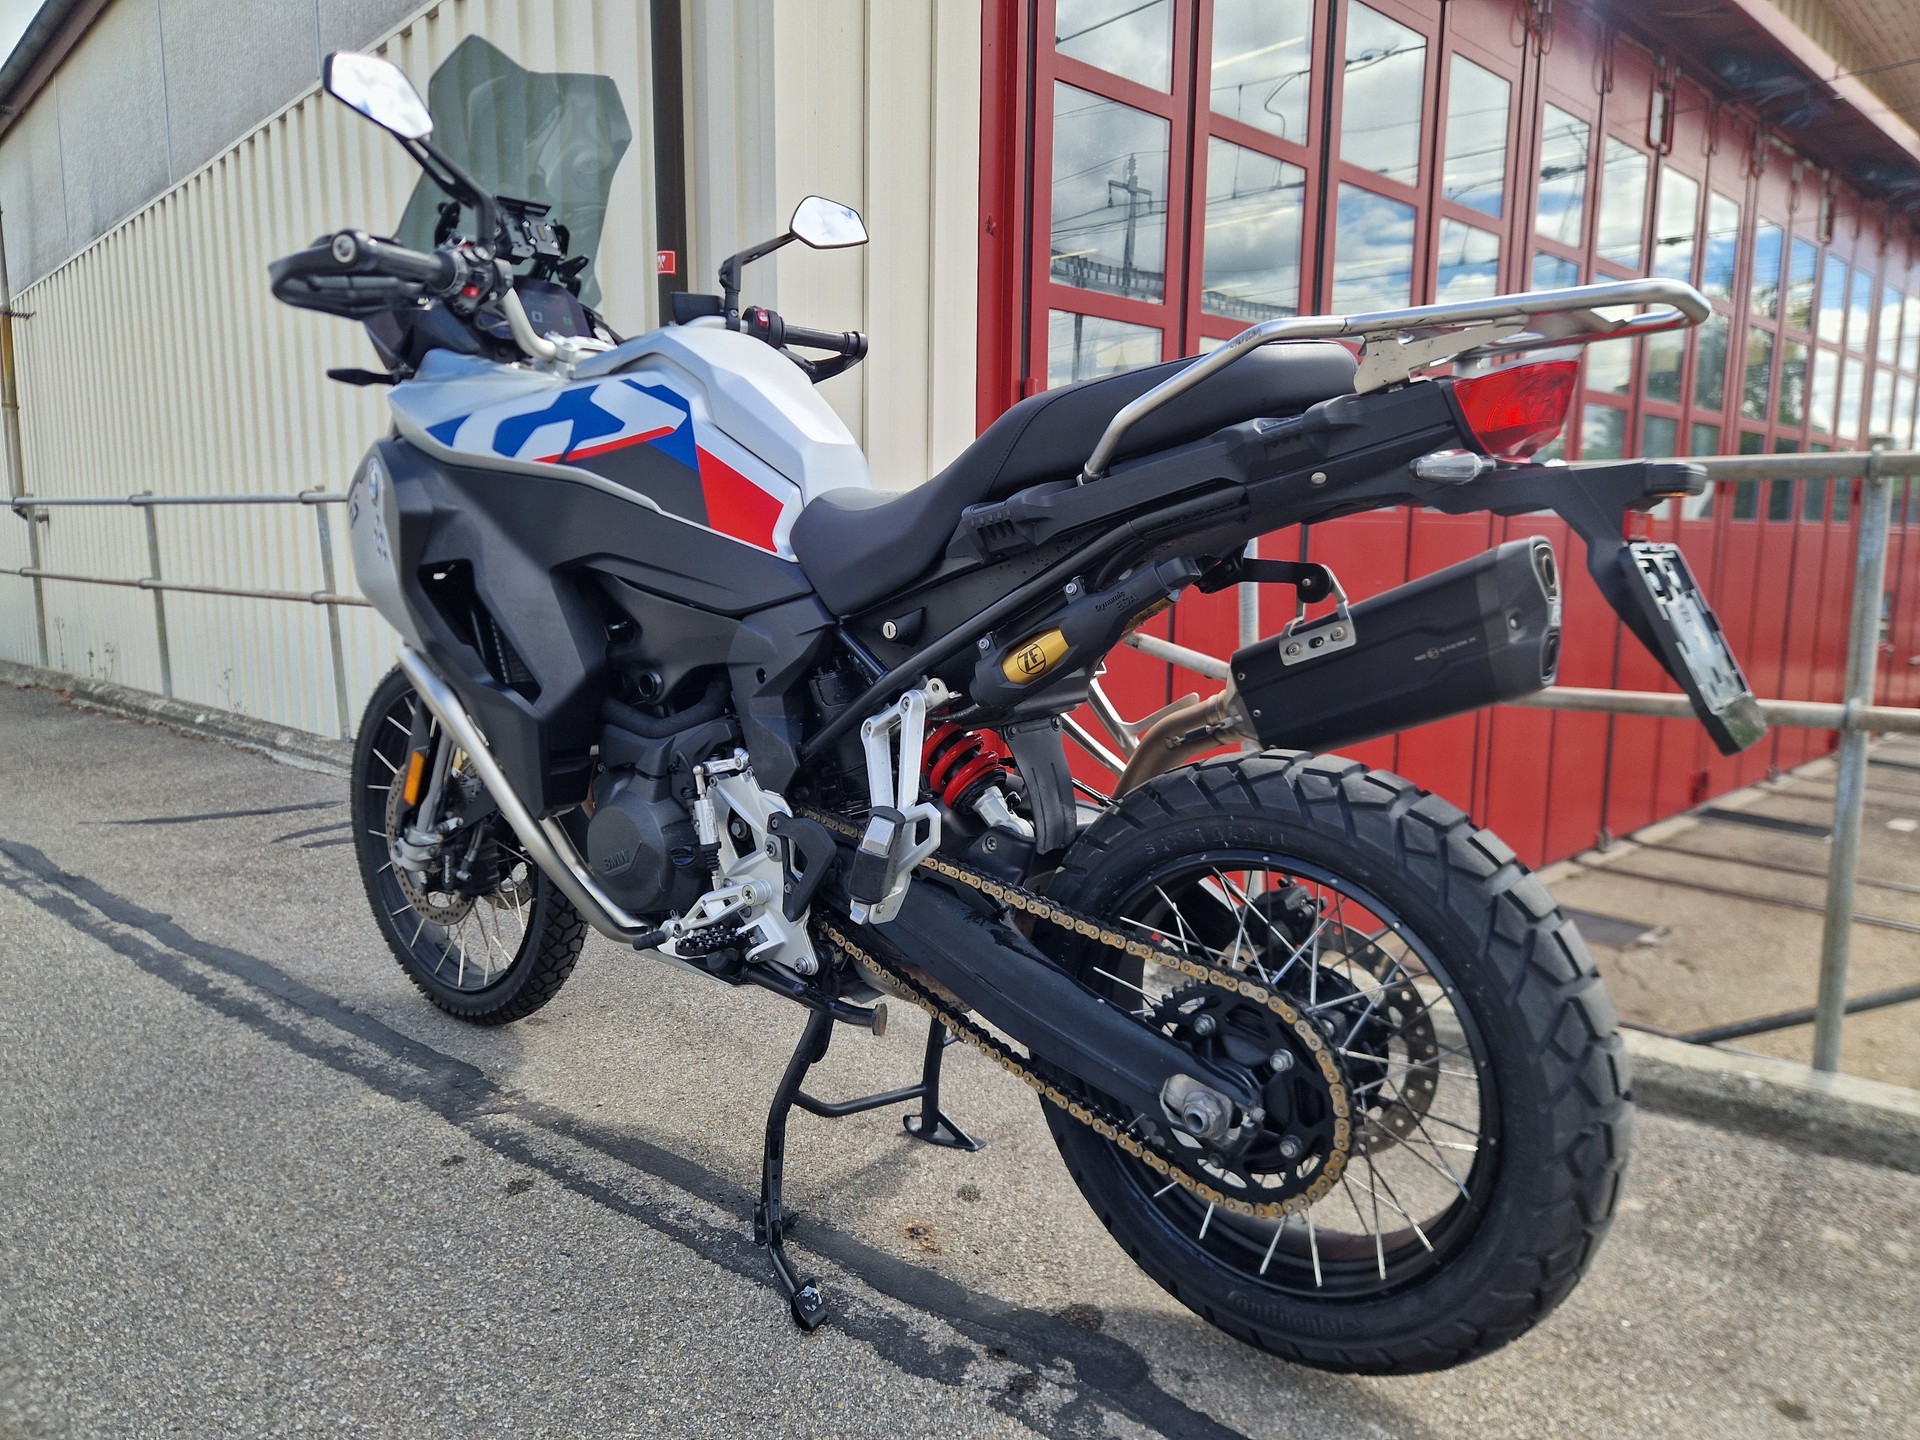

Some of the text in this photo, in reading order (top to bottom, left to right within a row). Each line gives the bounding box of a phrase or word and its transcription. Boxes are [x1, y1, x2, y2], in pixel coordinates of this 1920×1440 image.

[1095, 591, 1126, 612] Dynamic
[1116, 593, 1139, 611] ESA
[1018, 645, 1045, 673] ZF
[602, 850, 629, 870] BMW
